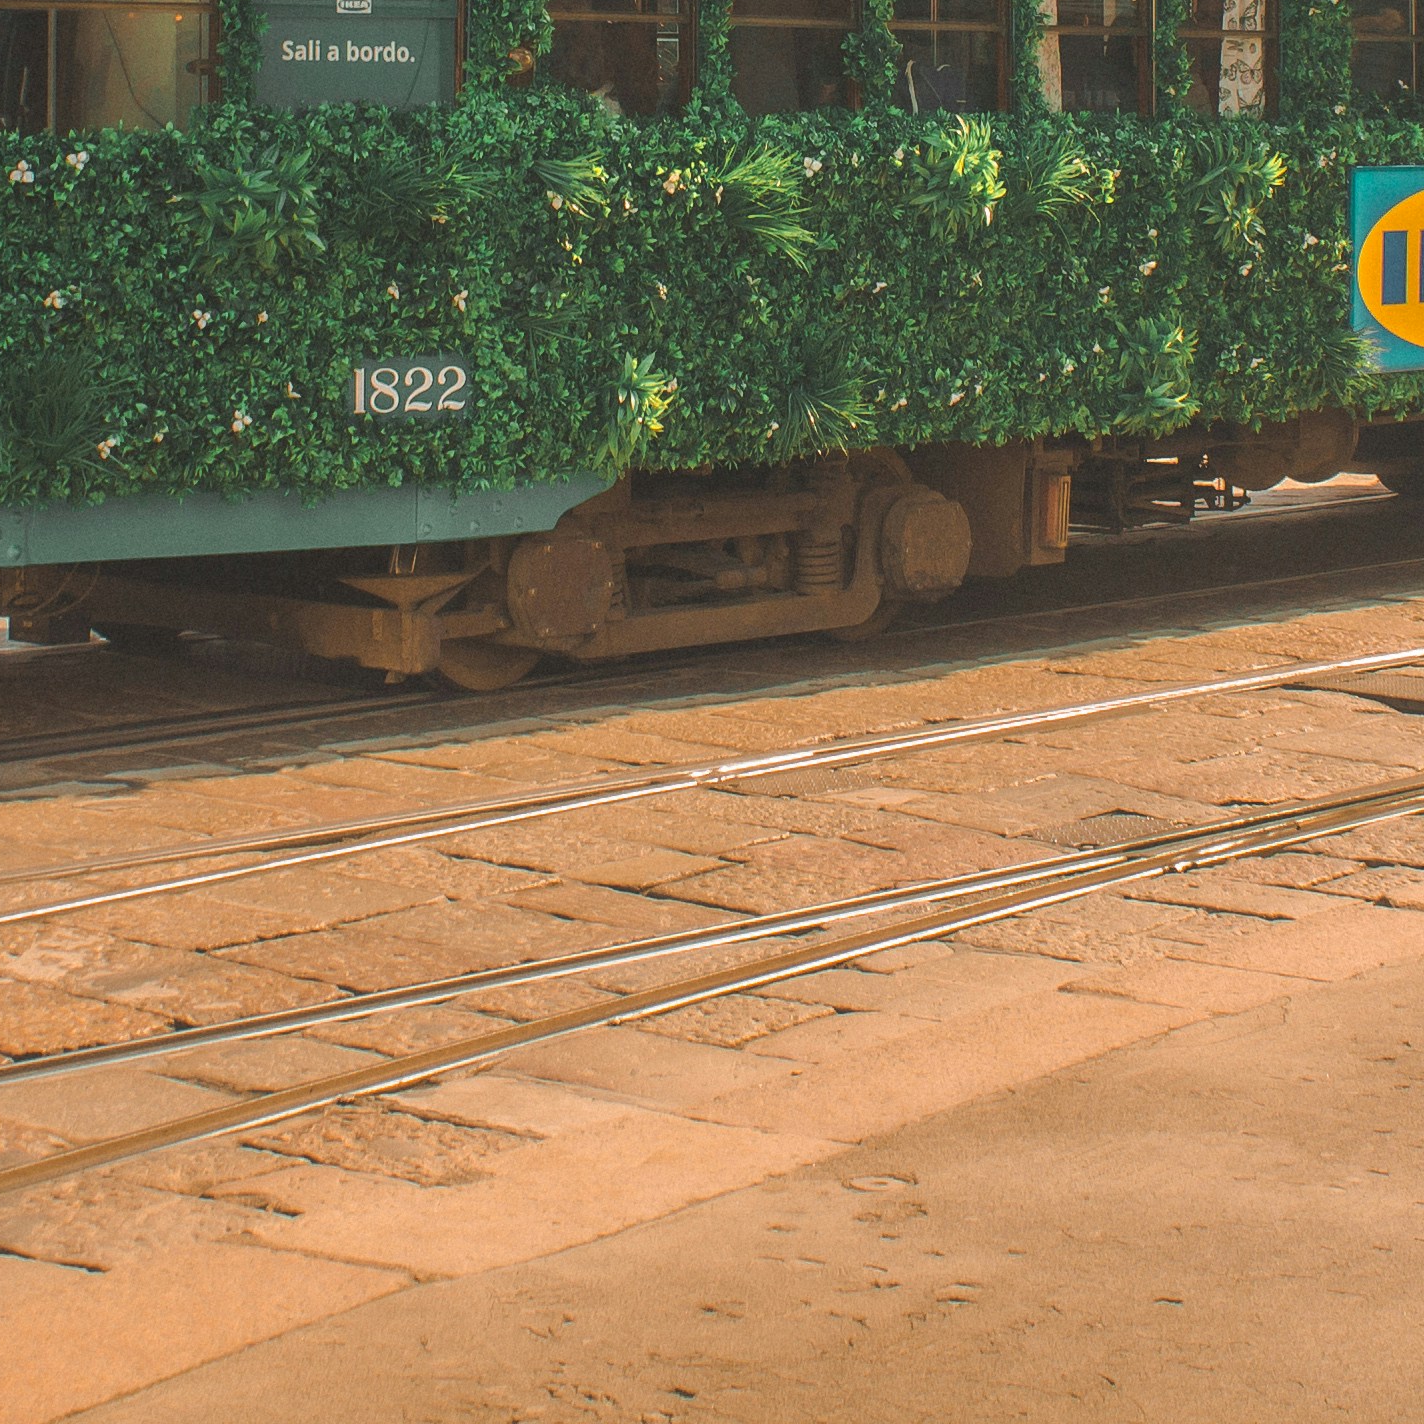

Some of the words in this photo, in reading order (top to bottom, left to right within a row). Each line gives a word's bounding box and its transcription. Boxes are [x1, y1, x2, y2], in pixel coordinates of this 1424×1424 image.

[340, 0, 369, 9] IKEA
[281, 39, 322, 62] Sali
[326, 45, 340, 62] a
[345, 40, 416, 64] bordo.
[353, 364, 467, 415] 1822
